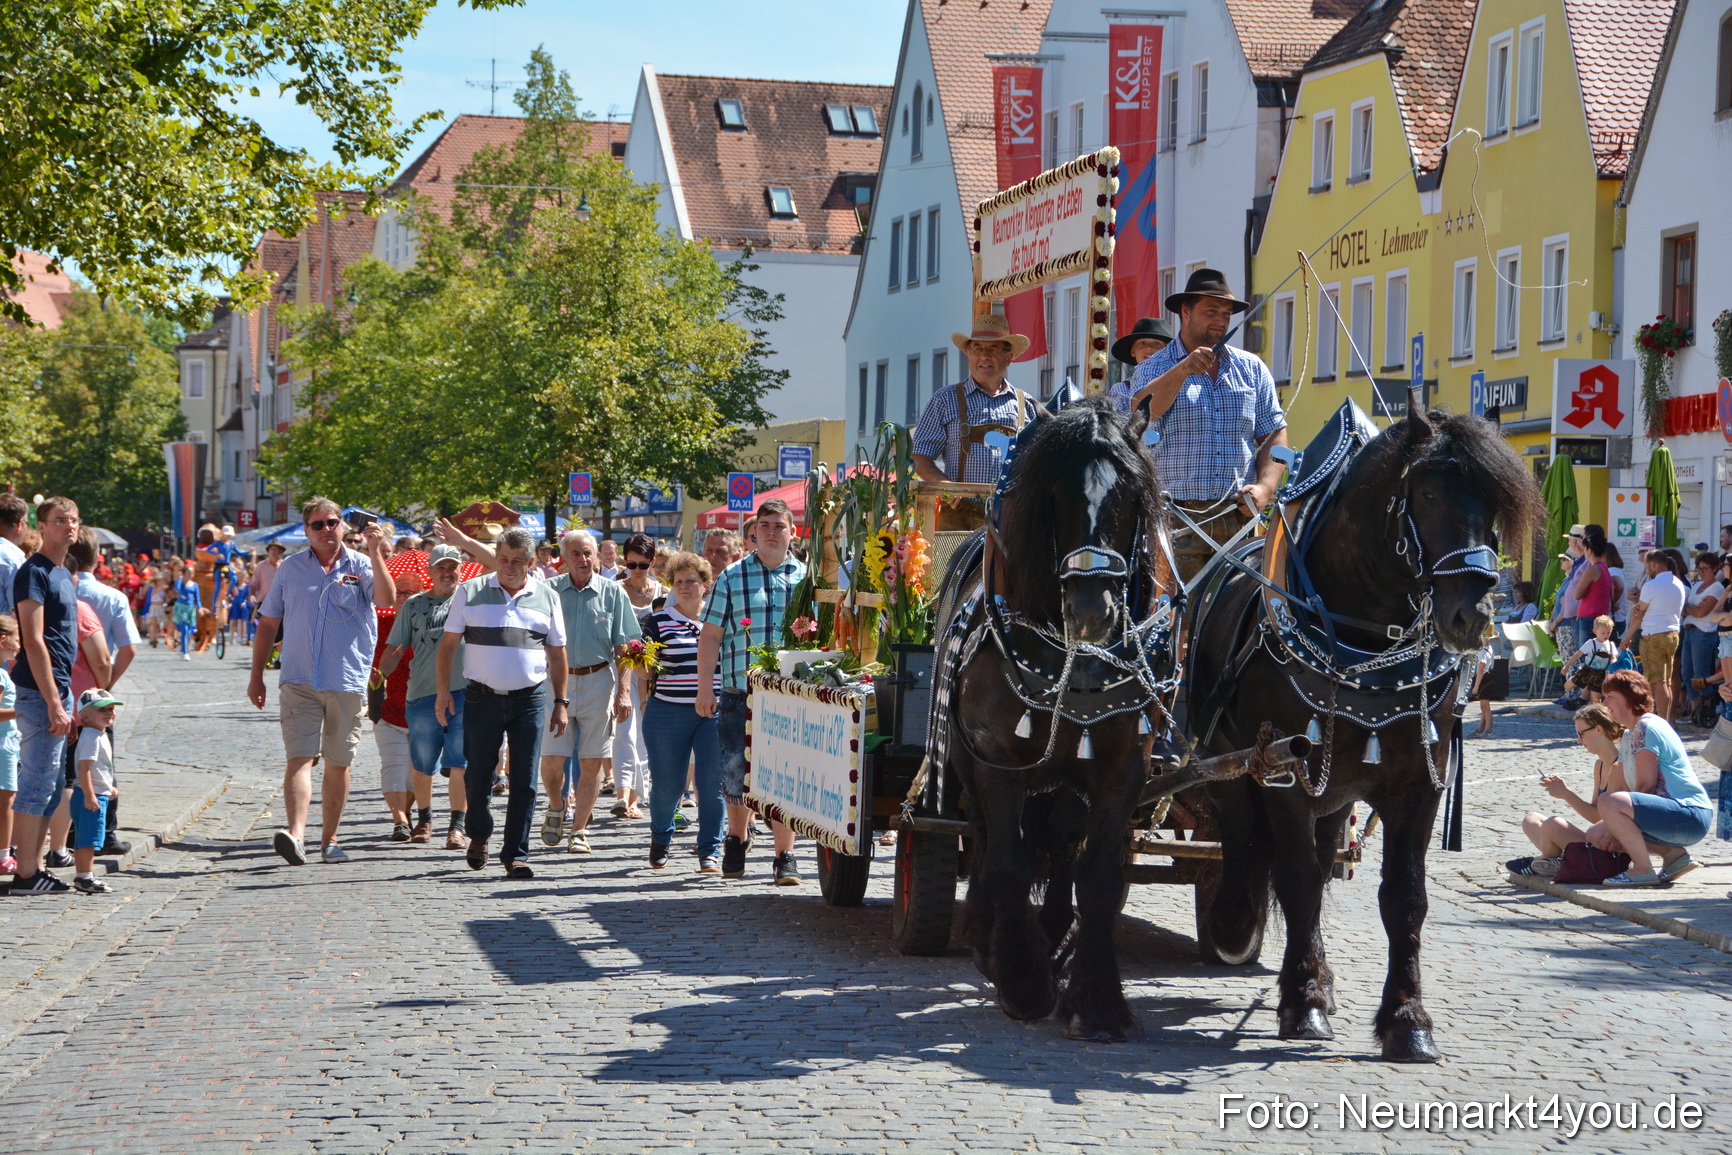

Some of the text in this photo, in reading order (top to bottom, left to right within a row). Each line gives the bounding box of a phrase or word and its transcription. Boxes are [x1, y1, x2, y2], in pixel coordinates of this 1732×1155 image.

[1115, 35, 1143, 110] K&L
[1141, 36, 1154, 110] RUPPERT
[993, 206, 1024, 246] Neumarkter
[1329, 221, 1429, 270] HOTEL Lehmeier
[1482, 382, 1517, 409] AIFUN
[572, 494, 590, 502] TAXI
[730, 499, 752, 509] TAXI
[241, 512, 253, 525] T
